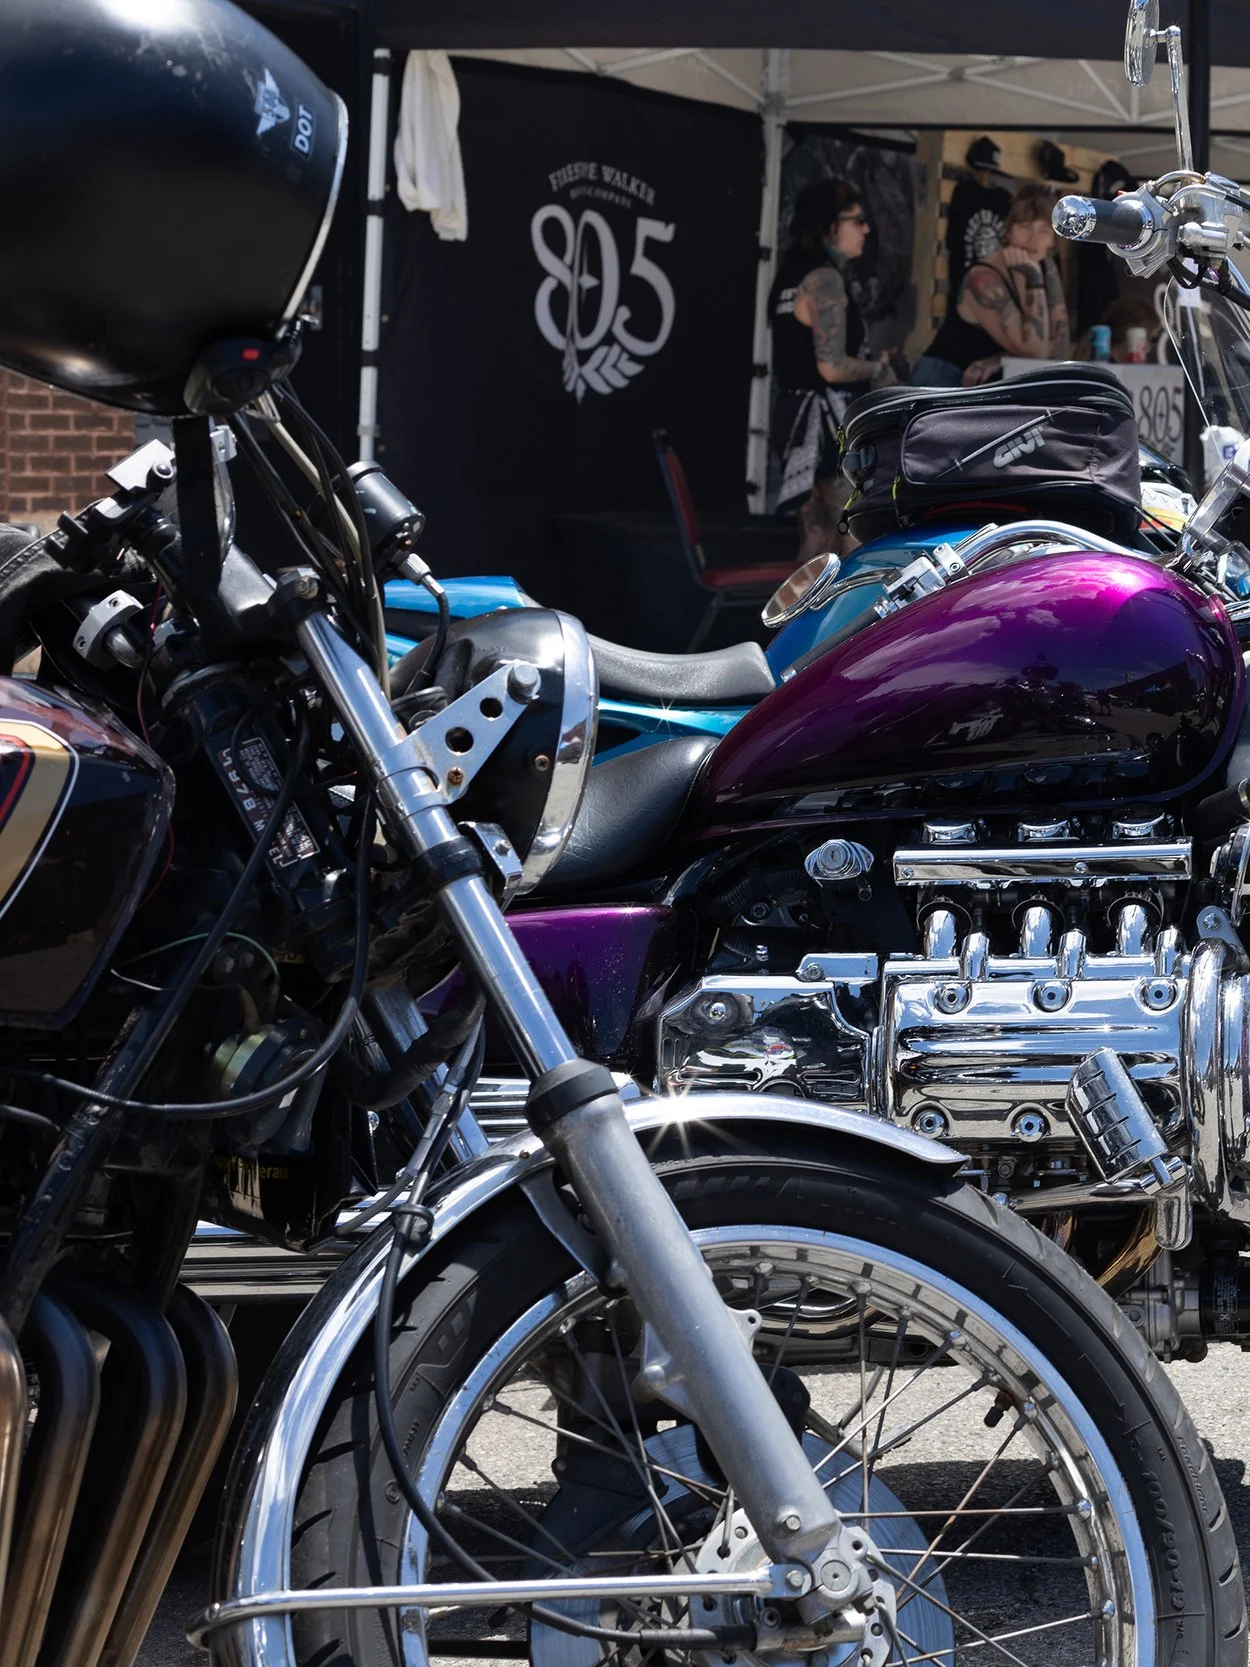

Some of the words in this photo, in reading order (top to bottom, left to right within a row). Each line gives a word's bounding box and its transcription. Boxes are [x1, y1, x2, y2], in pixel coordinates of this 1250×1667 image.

[294, 104, 313, 154] DOT
[600, 163, 656, 206] WALKER
[530, 203, 676, 357] 805
[1138, 386, 1184, 443] 805
[993, 428, 1045, 468] GIVI
[253, 819, 283, 864] MEL
[1142, 1470, 1186, 1612] 100/90-19
